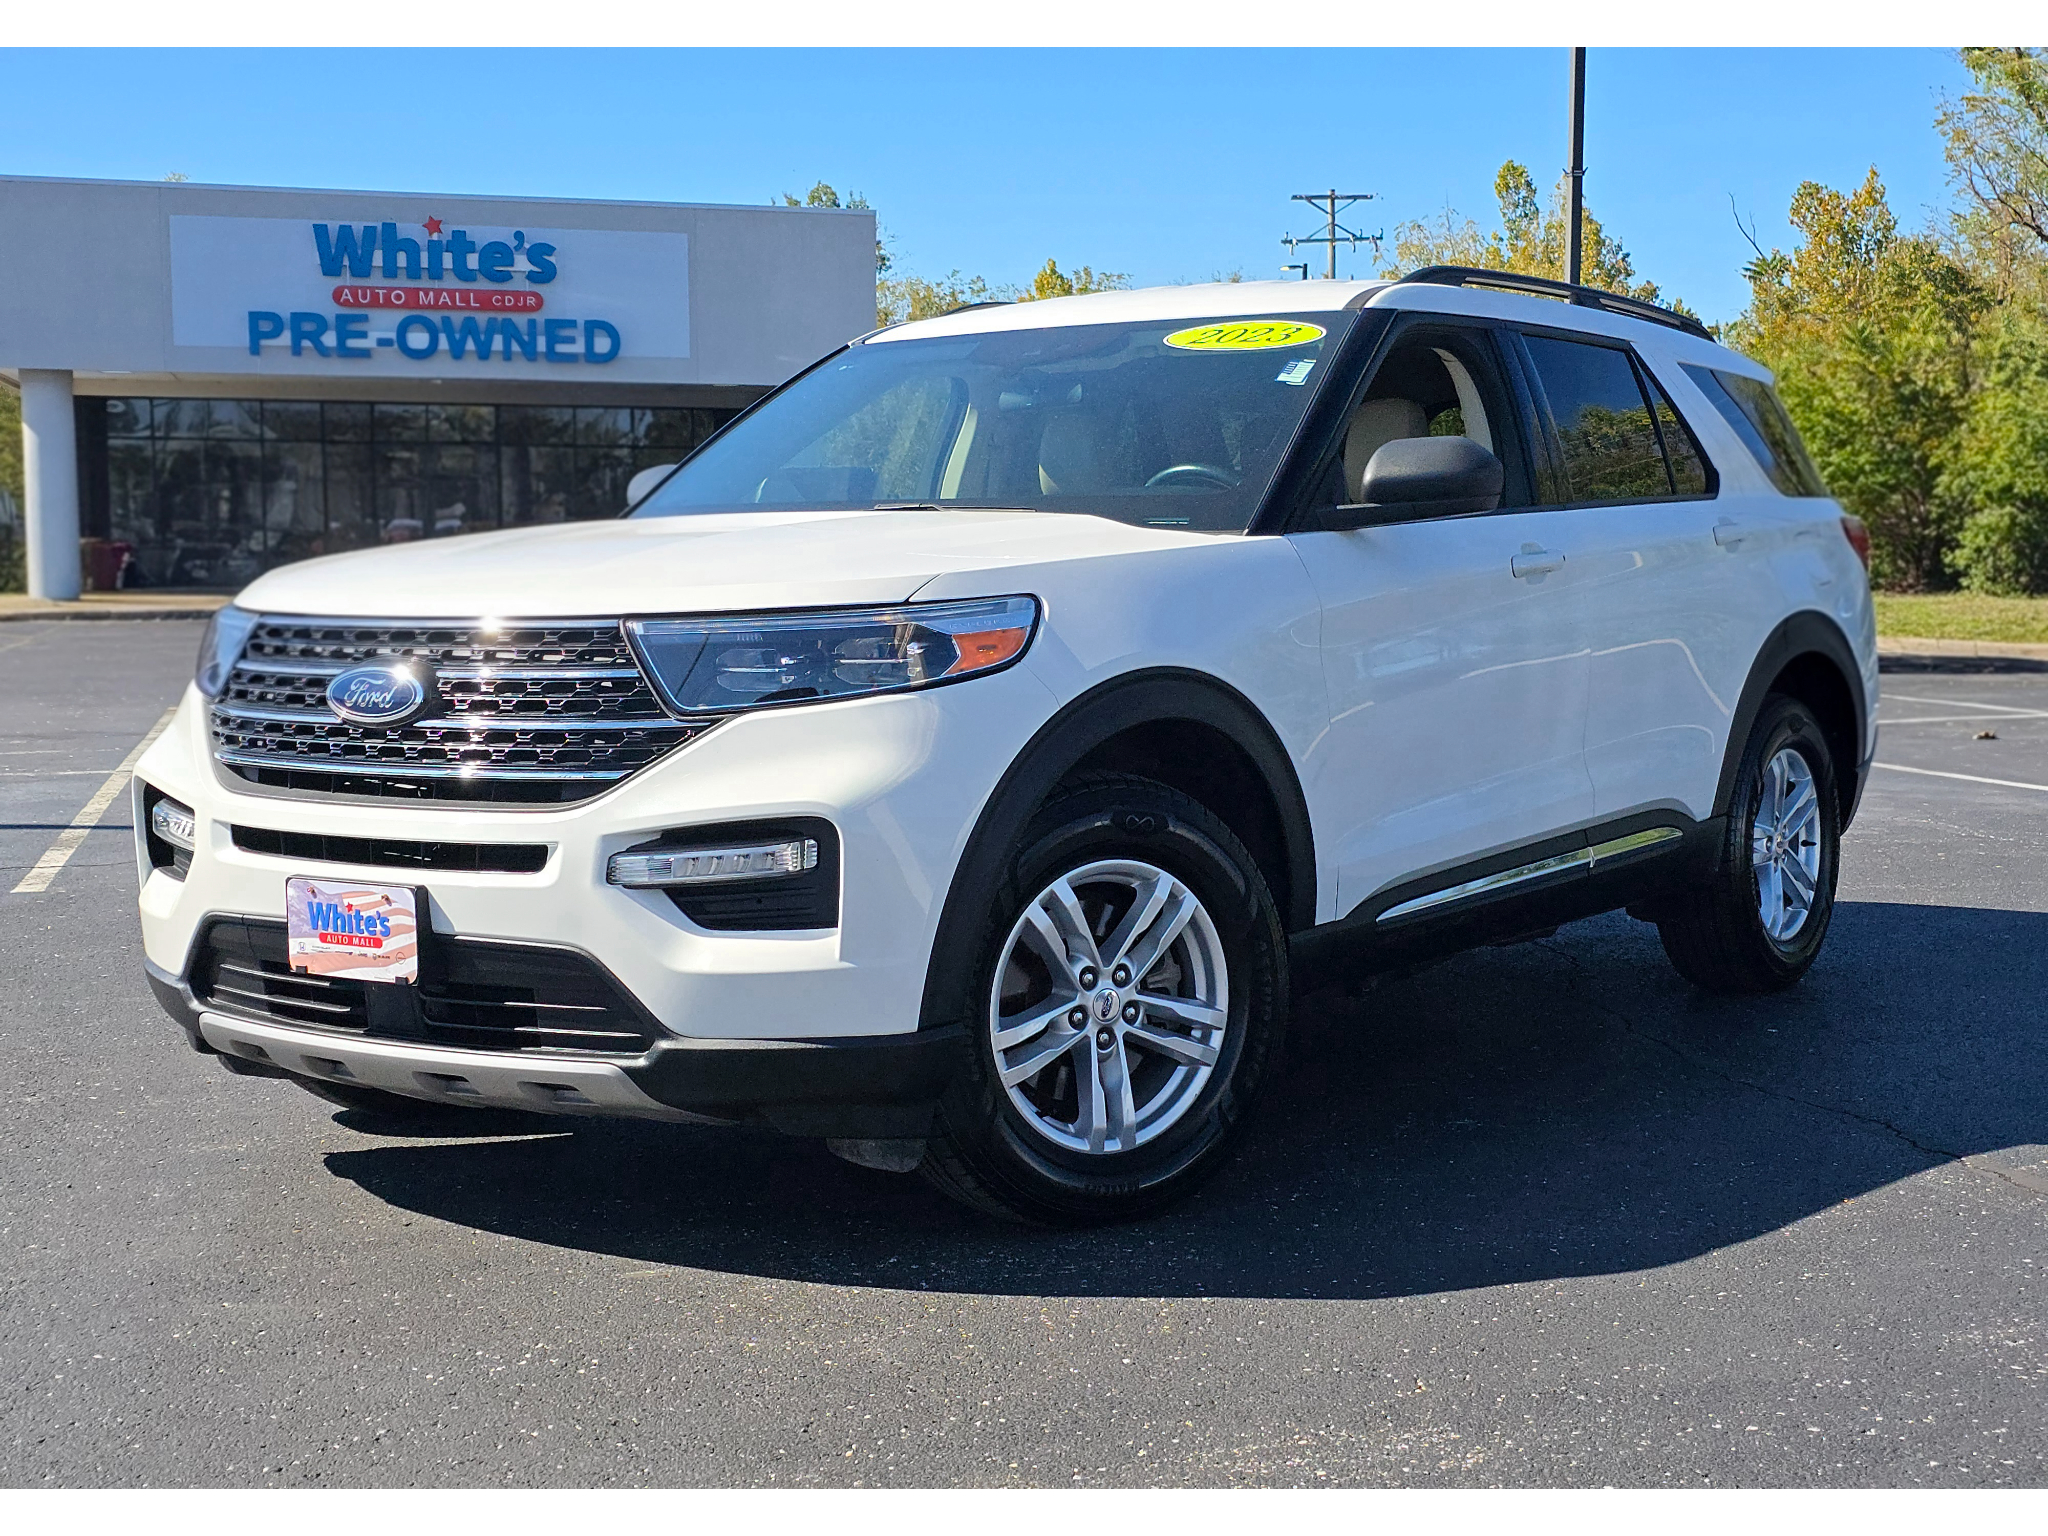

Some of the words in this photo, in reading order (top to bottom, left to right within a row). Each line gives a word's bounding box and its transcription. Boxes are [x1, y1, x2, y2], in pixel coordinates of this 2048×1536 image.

[313, 215, 558, 284] White's
[340, 288, 406, 305] AUTO
[419, 290, 480, 307] MALL
[492, 295, 536, 307] CDJR
[248, 310, 621, 364] PRE-OWNED
[1187, 327, 1302, 344] 2023
[343, 677, 398, 709] Ford
[307, 901, 391, 938] White's
[326, 934, 349, 945] AUTO
[352, 936, 374, 947] MALL
